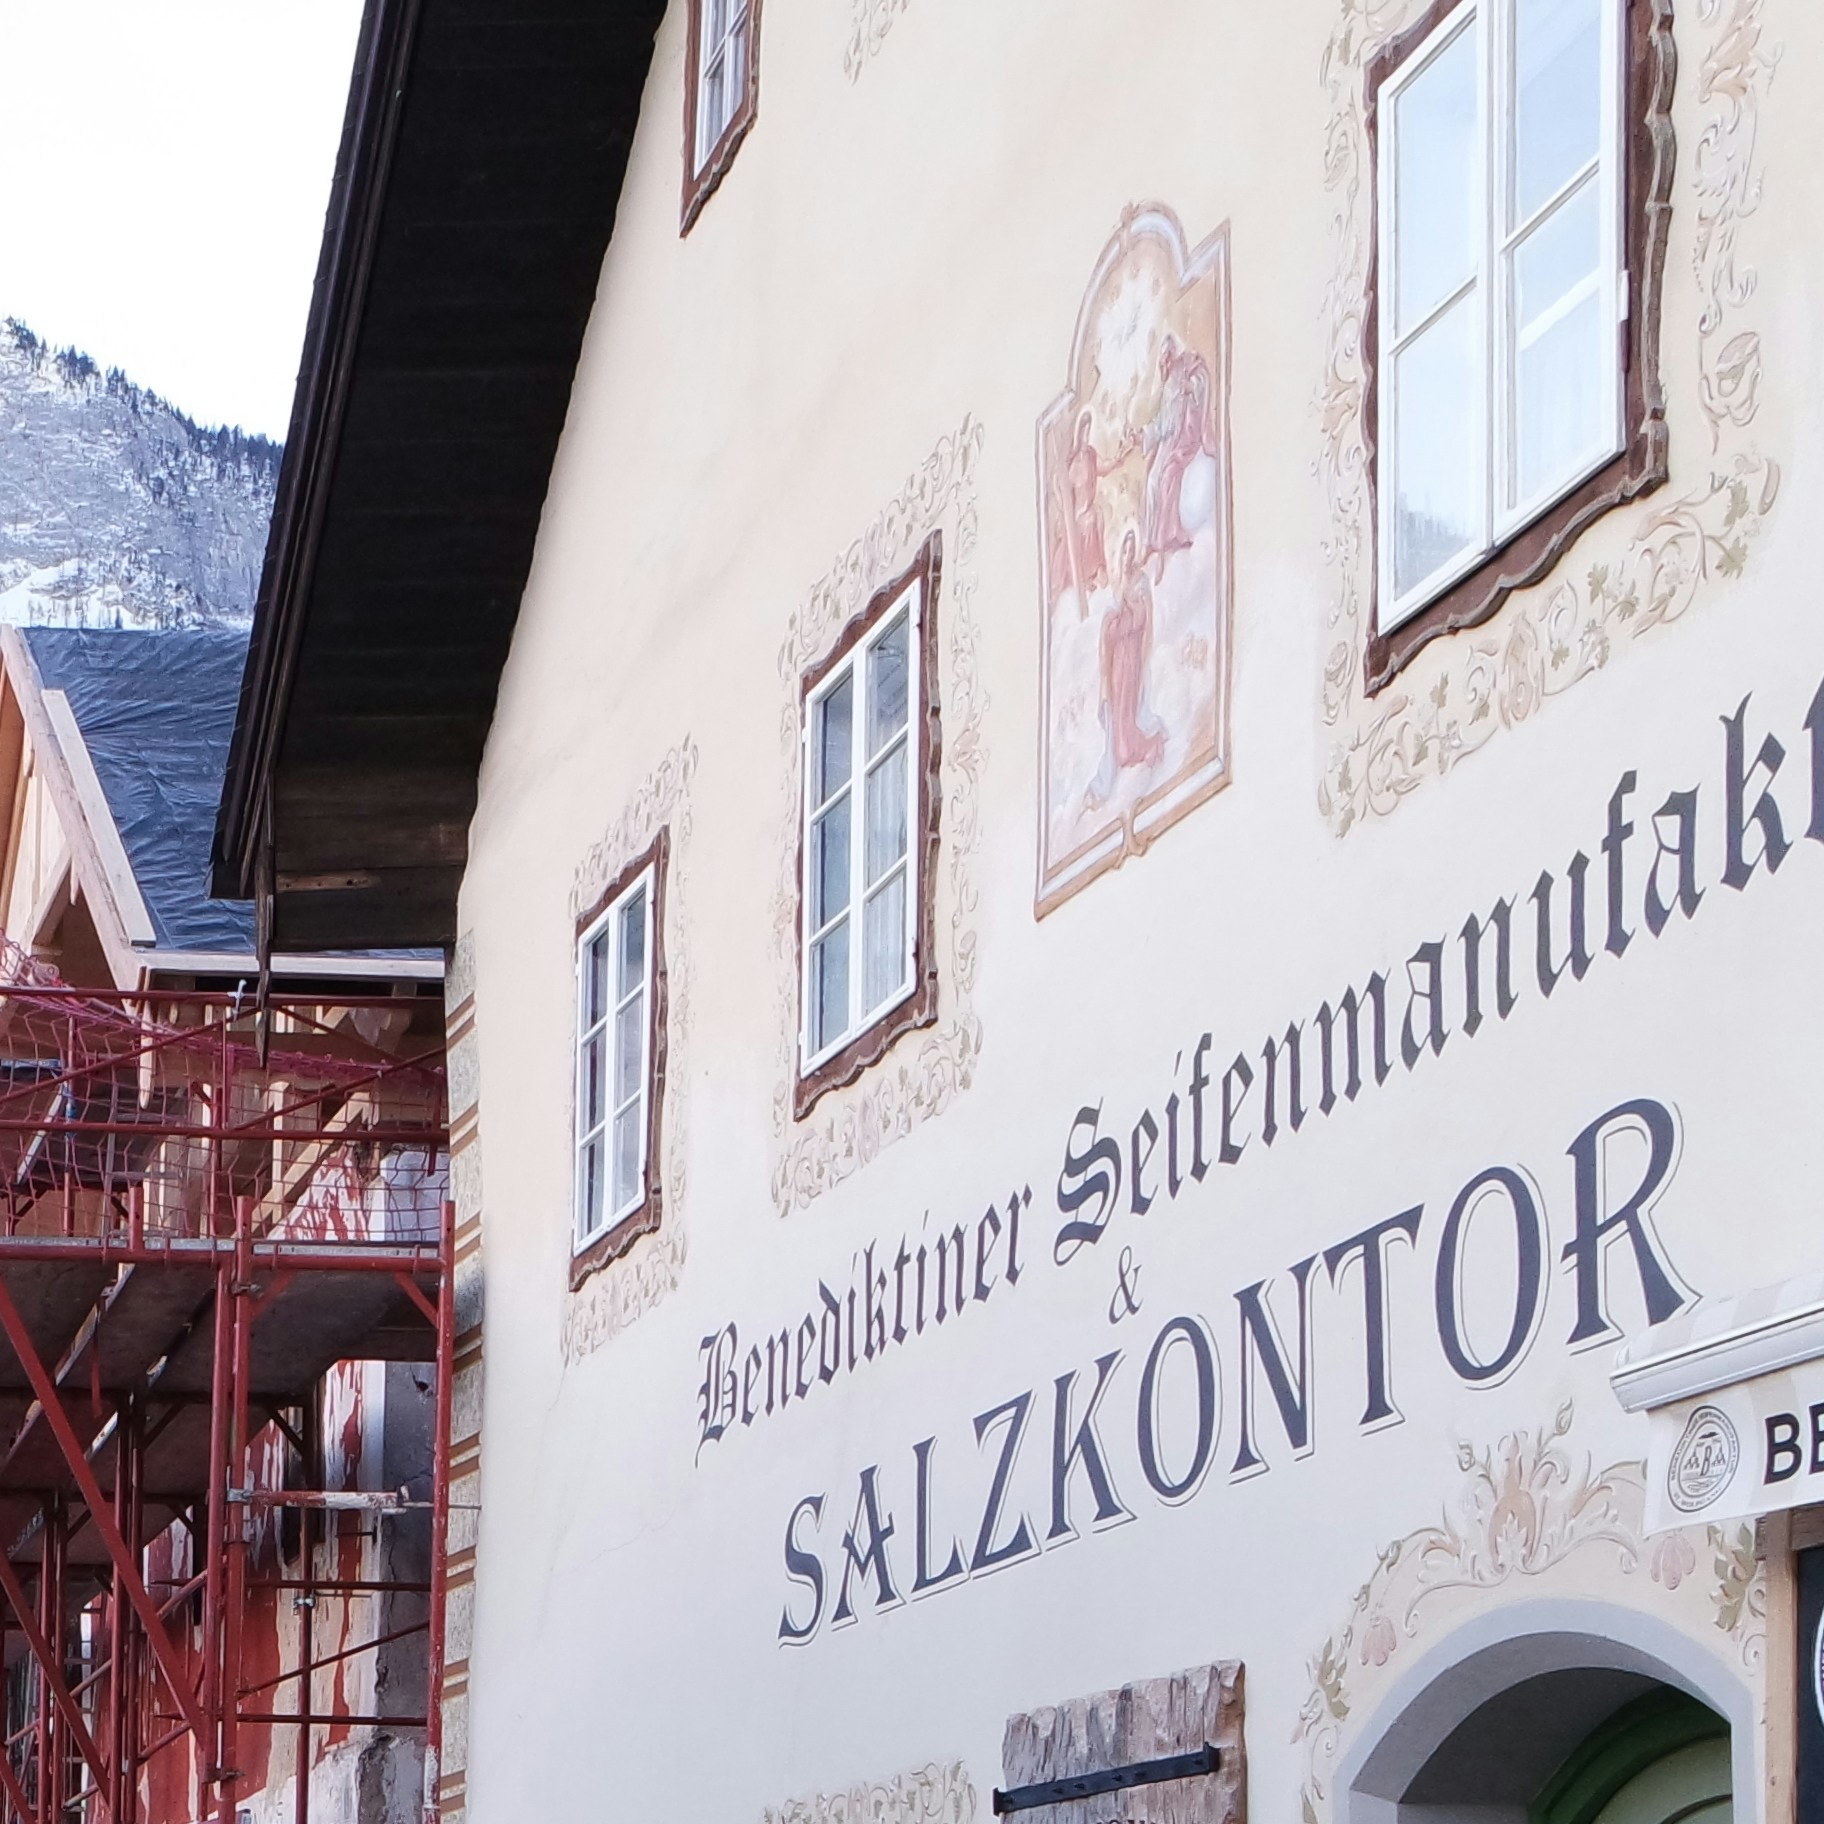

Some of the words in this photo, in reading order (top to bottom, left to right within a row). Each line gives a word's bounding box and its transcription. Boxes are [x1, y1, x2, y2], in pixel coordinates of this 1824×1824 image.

[695, 1179, 1035, 1469] Benediktiner
[779, 1097, 1705, 1652] SALZKONTOR
[1107, 1246, 1145, 1324] &
